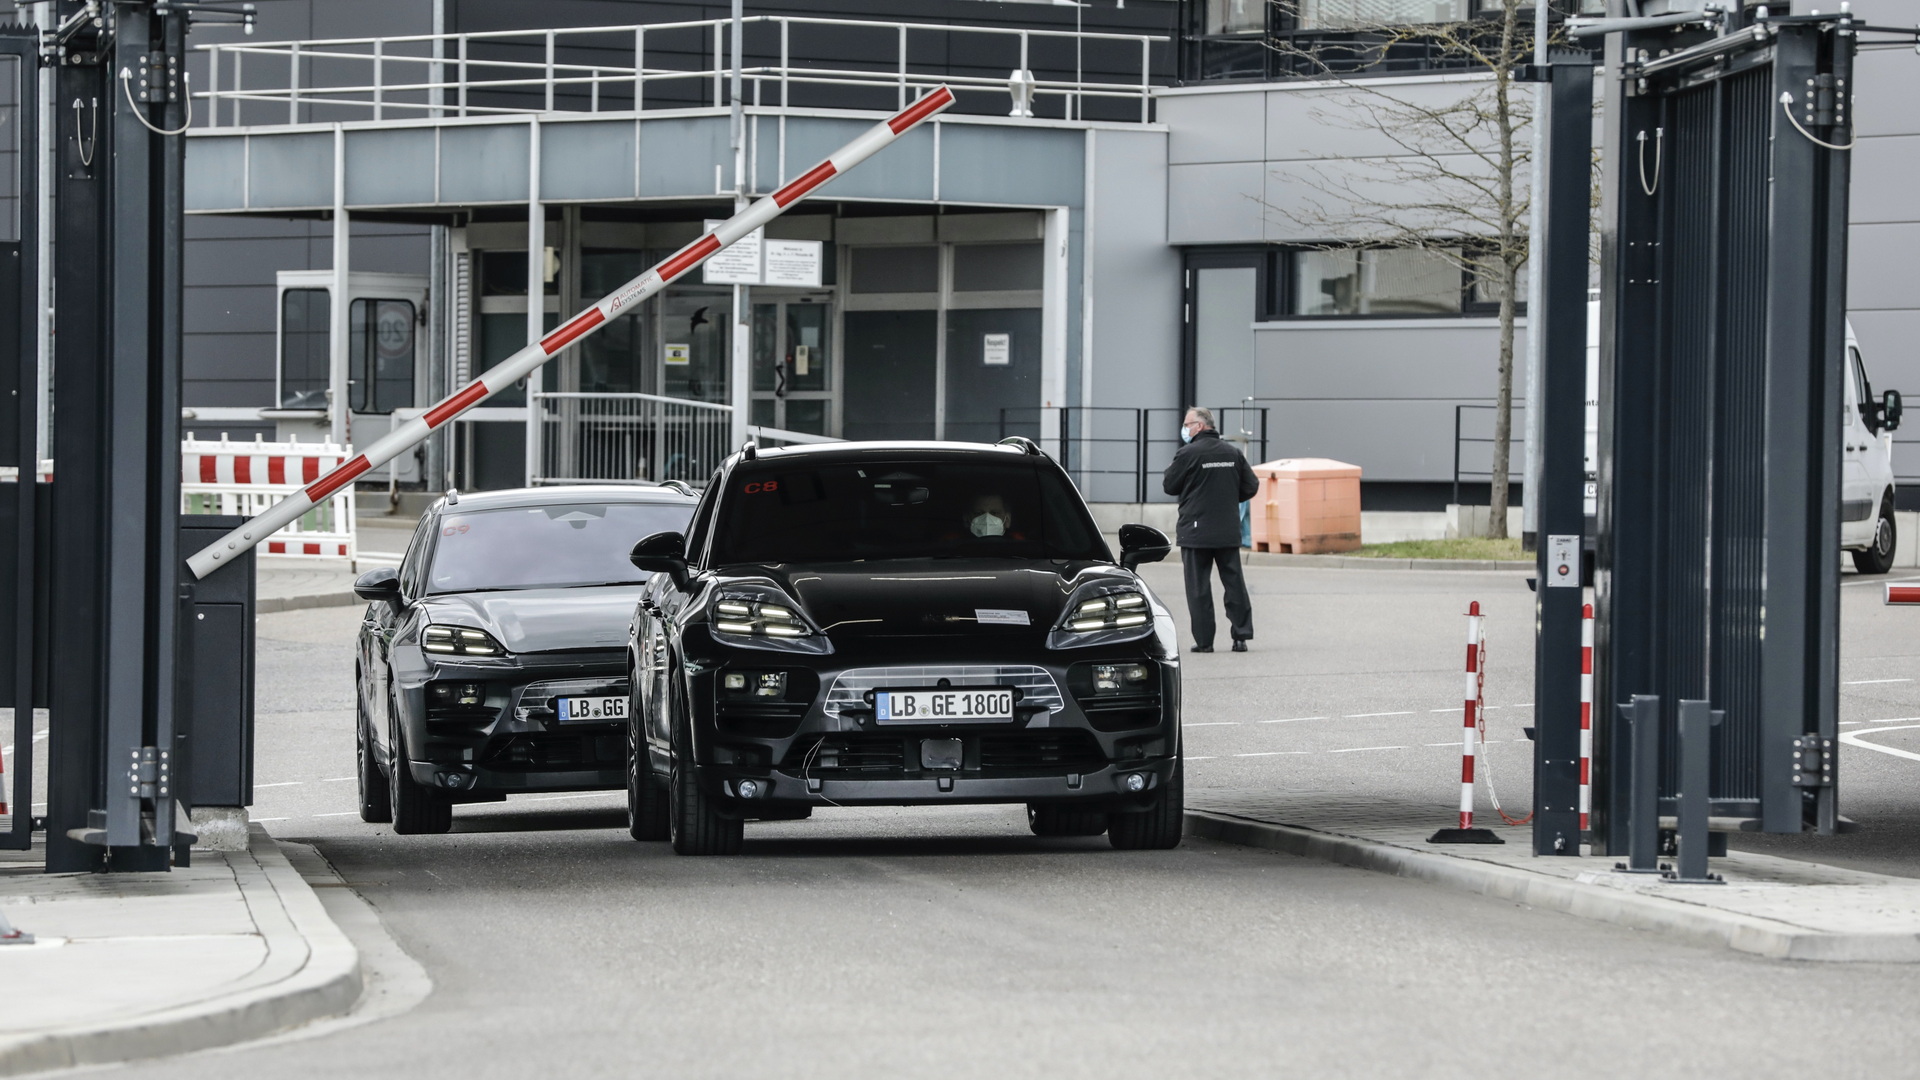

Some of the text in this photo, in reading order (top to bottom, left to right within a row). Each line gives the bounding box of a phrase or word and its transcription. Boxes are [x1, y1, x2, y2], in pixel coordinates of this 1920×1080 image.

[620, 275, 654, 299] AUTOMATIC
[621, 286, 647, 306] SYSTEMS
[744, 480, 779, 494] C8
[442, 523, 471, 537] C9
[569, 700, 590, 718] LB
[602, 698, 624, 717] GG
[891, 695, 916, 716] LB
[932, 694, 957, 716] GE
[962, 693, 1010, 715] 1800
